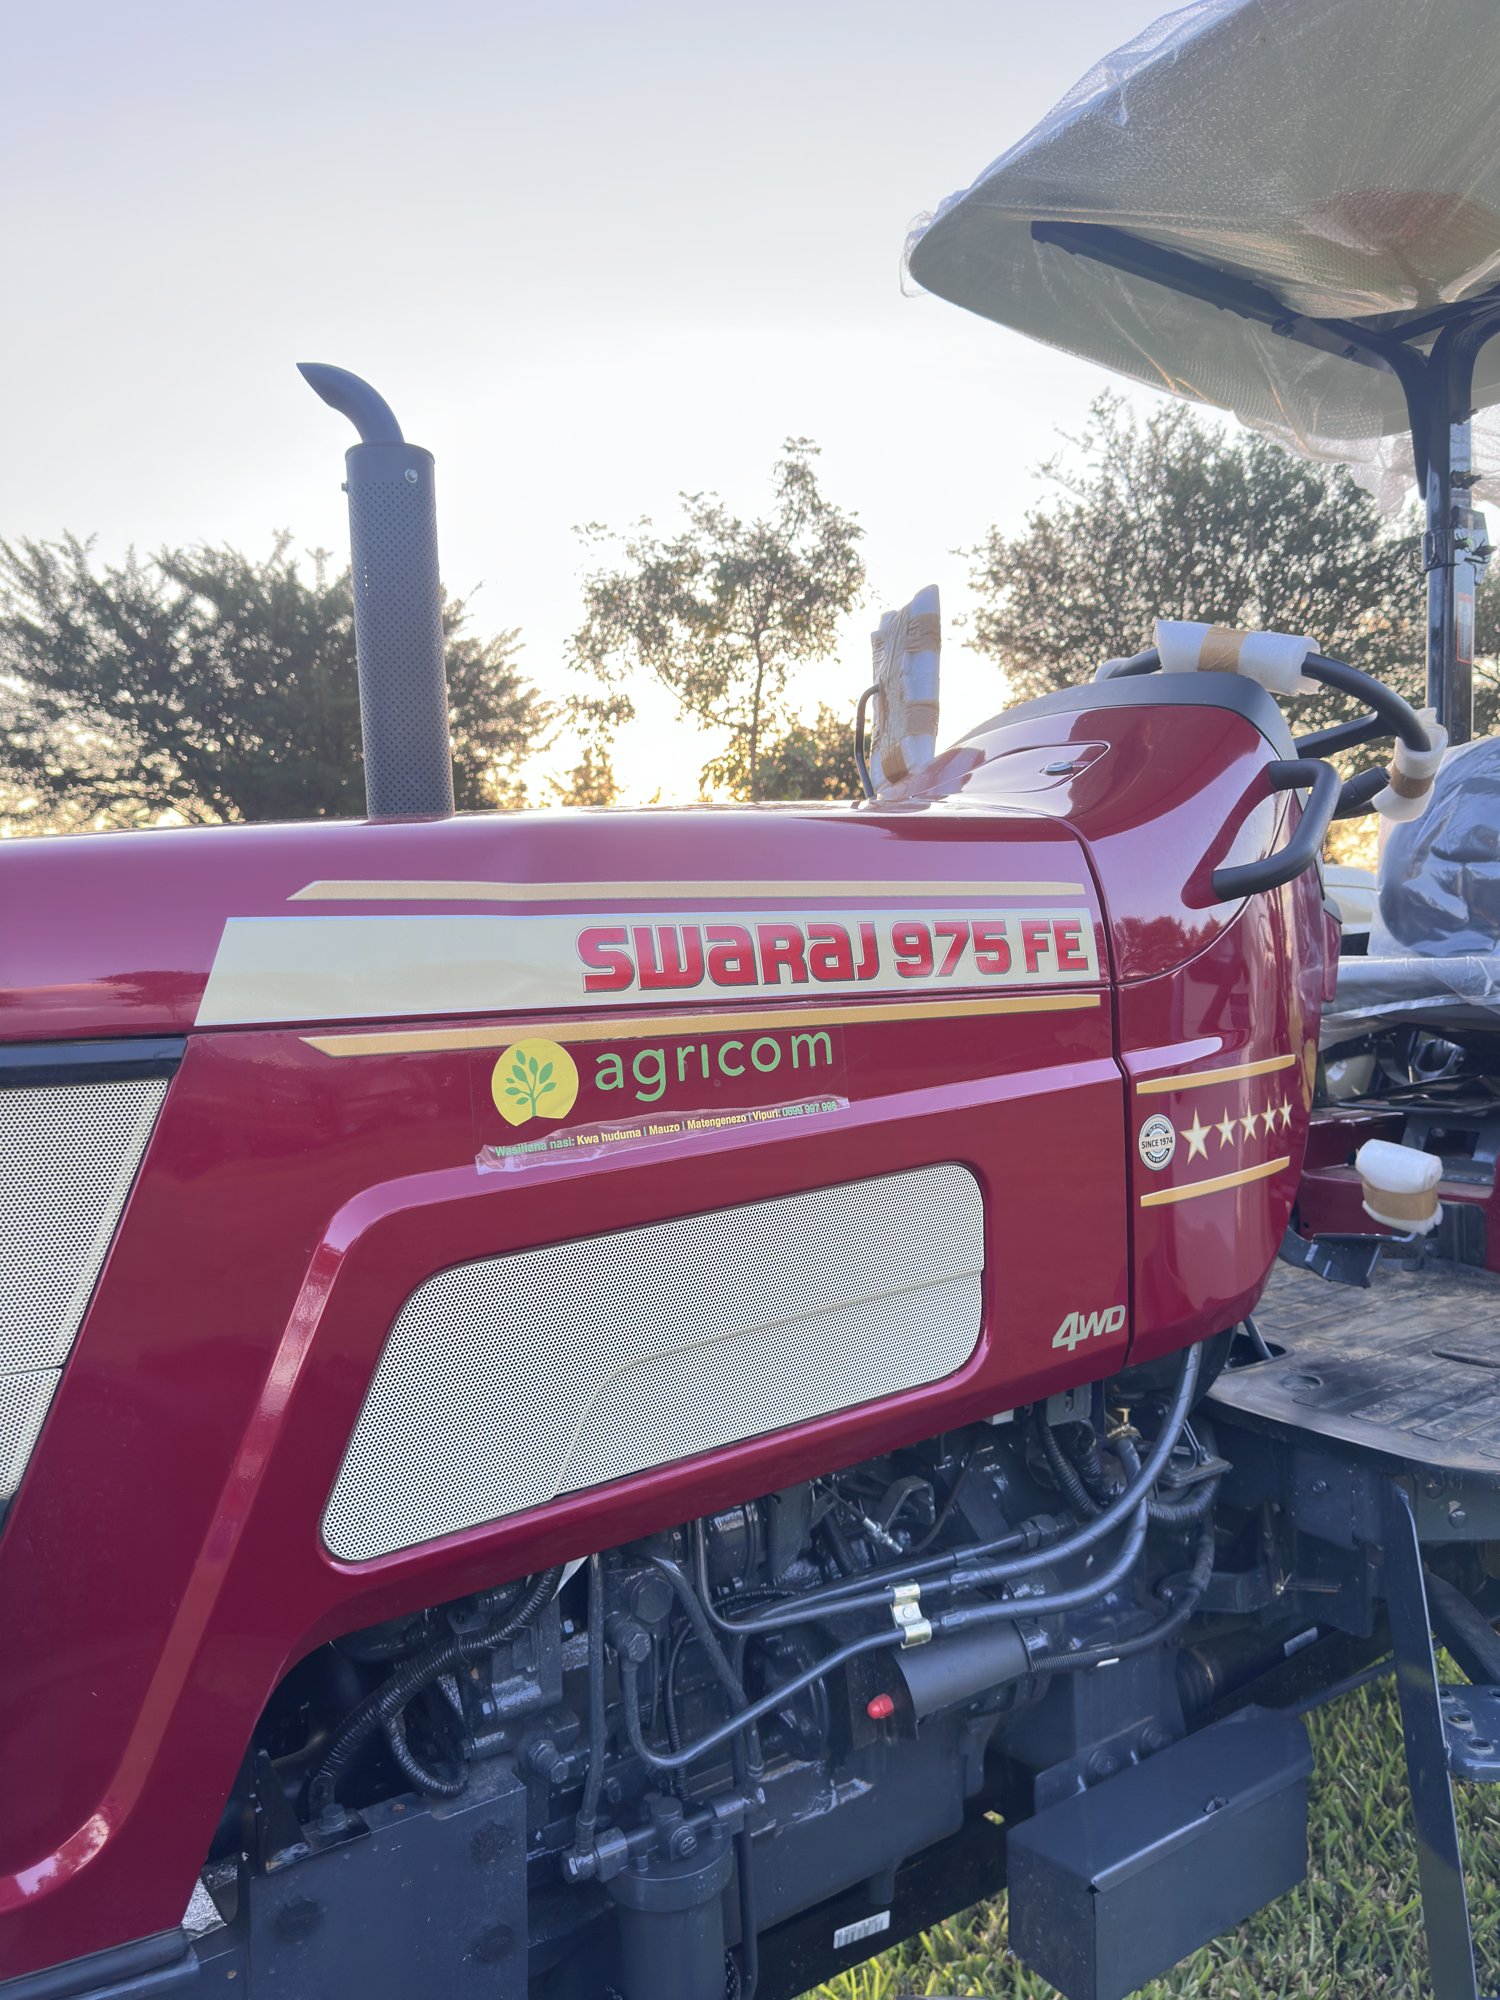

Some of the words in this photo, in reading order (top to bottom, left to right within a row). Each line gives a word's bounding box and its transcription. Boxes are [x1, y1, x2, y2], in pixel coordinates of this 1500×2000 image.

[891, 918, 1012, 979] 975
[1018, 917, 1089, 973] FE
[594, 1030, 833, 1102] agricom
[494, 1141, 548, 1158] Wasiliana
[550, 1136, 575, 1150] nasi:
[577, 1134, 600, 1146] Kwa
[601, 1127, 642, 1143] huduma
[649, 1124, 680, 1136] Mauzo
[687, 1114, 747, 1130] Matengenezo
[1141, 1139, 1159, 1149] SINCE
[1160, 1136, 1173, 1146] 1974
[1052, 1304, 1126, 1351] 4WD
